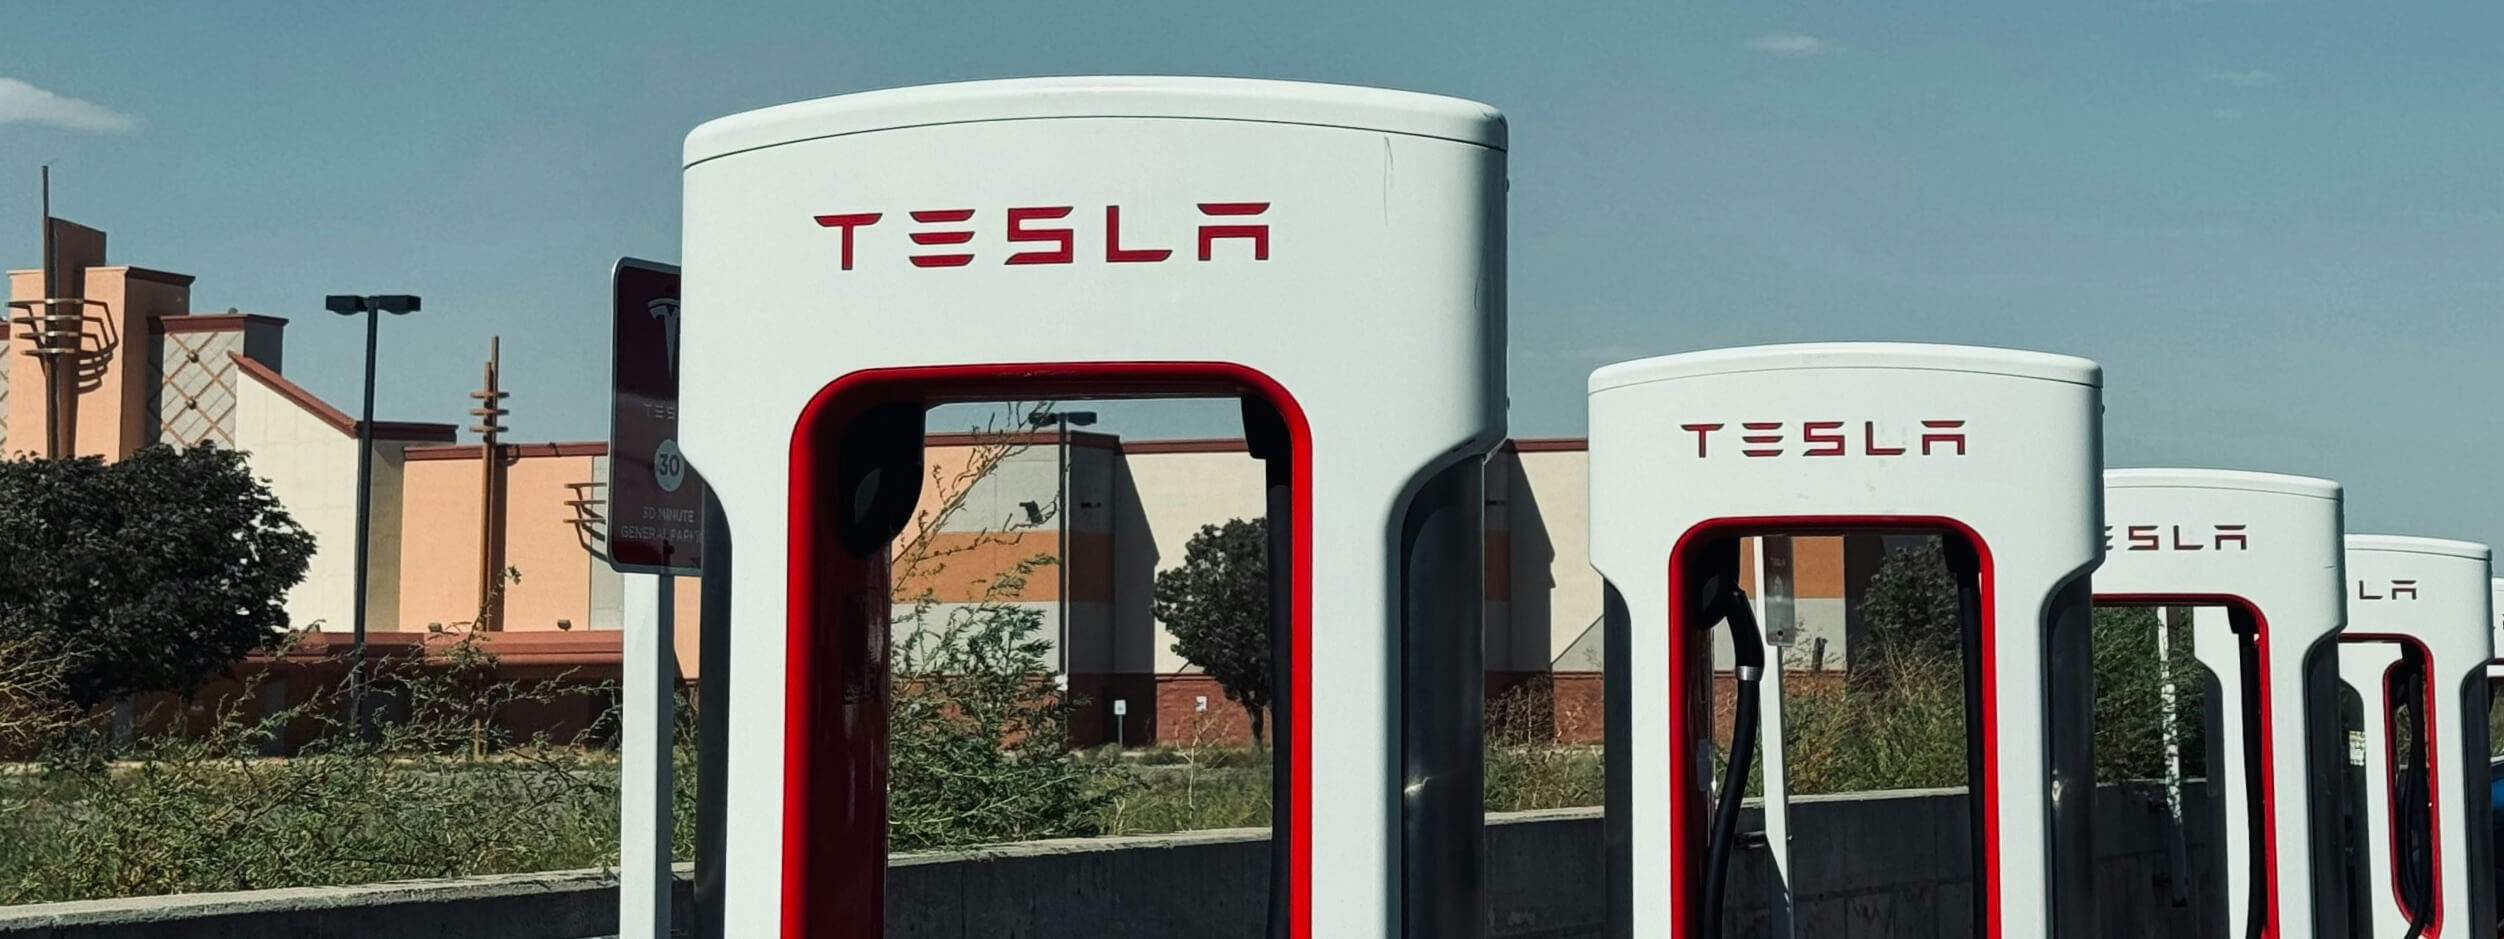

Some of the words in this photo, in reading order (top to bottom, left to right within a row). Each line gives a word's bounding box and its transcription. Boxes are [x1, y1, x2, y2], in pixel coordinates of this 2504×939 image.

[814, 201, 1270, 271] TESLA
[1681, 420, 1967, 458] TESLA
[658, 453, 680, 477] 30
[642, 505, 656, 520] 30
[658, 507, 695, 523] MINUTE
[620, 525, 670, 541] GENERAL
[2104, 524, 2247, 551] SLA
